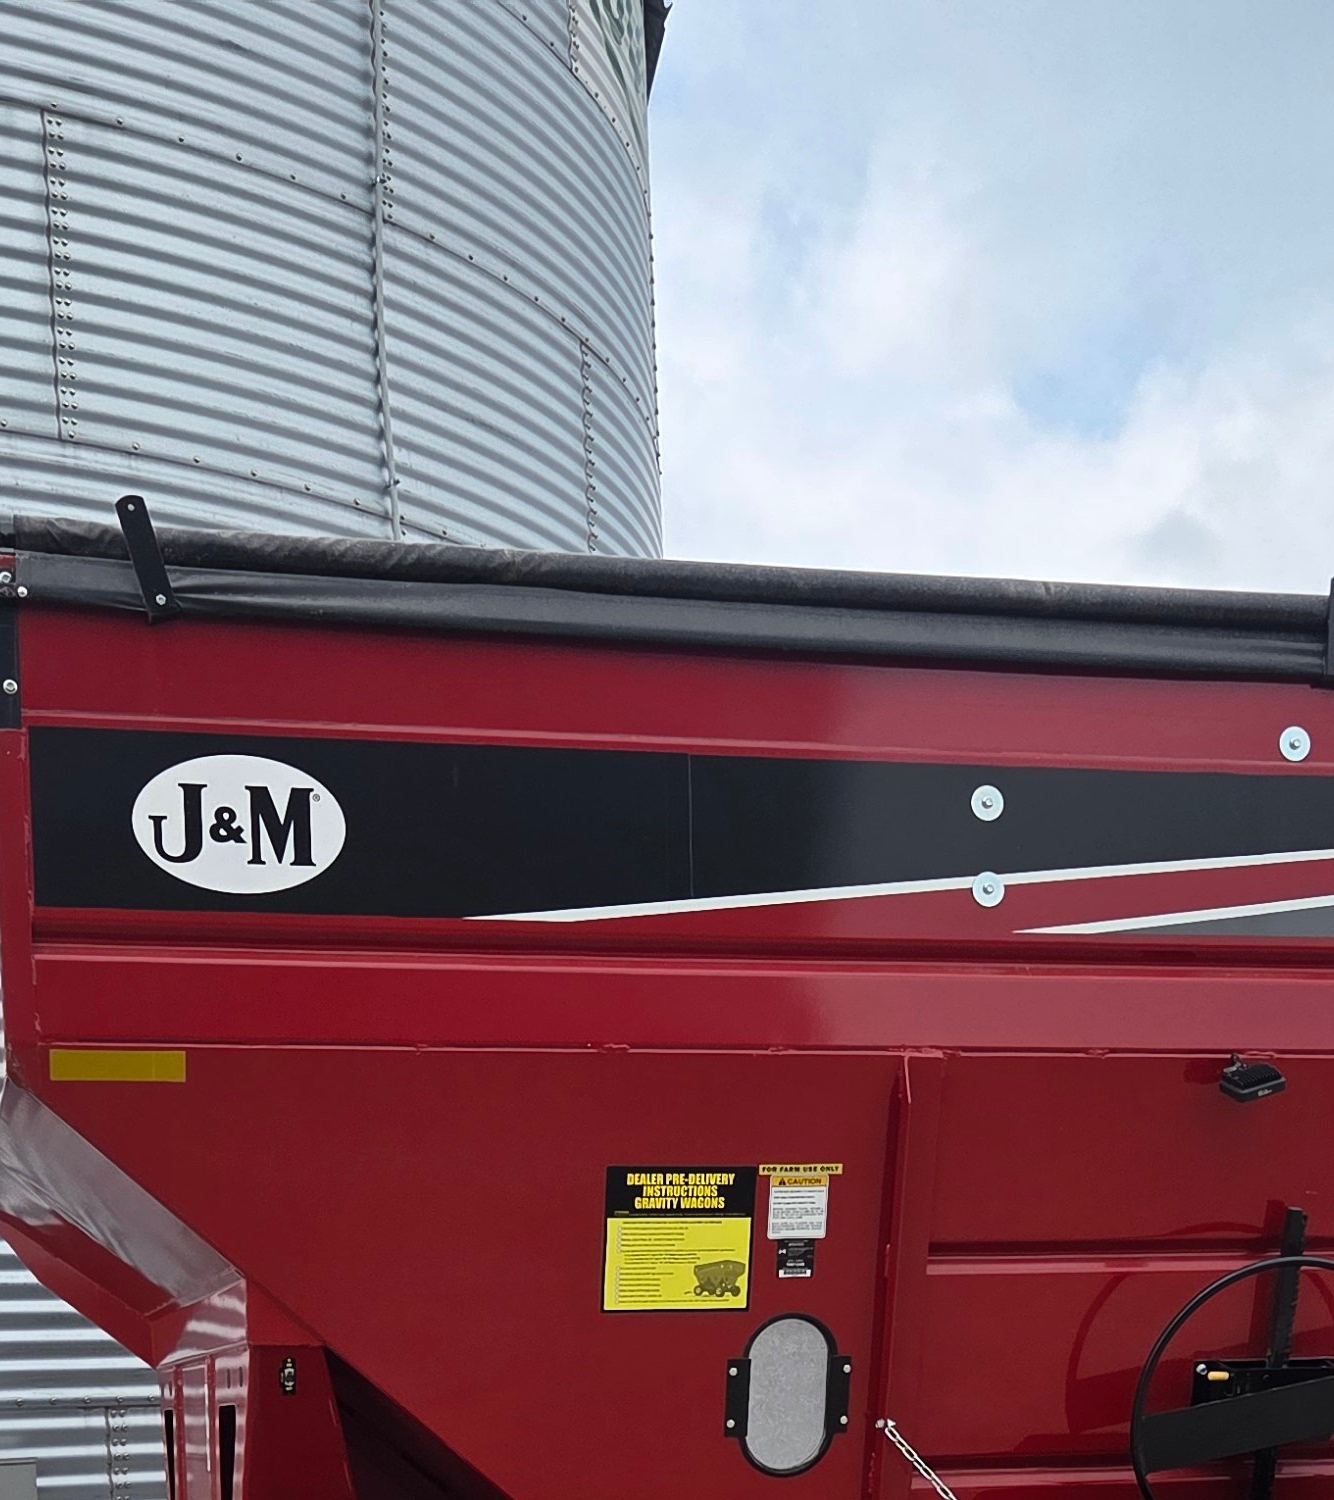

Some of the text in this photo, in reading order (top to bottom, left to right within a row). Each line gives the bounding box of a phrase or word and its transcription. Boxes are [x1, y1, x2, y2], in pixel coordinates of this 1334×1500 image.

[148, 782, 317, 867] J&M
[762, 1165, 840, 1173] FOR FARM USE ONLY
[627, 1173, 735, 1185] DEALER PRE-DELIVERY
[787, 1177, 822, 1185] CAUTION
[642, 1185, 718, 1197] INSTRUCTIONS
[634, 1197, 725, 1209] GRAVITY WAGONS
